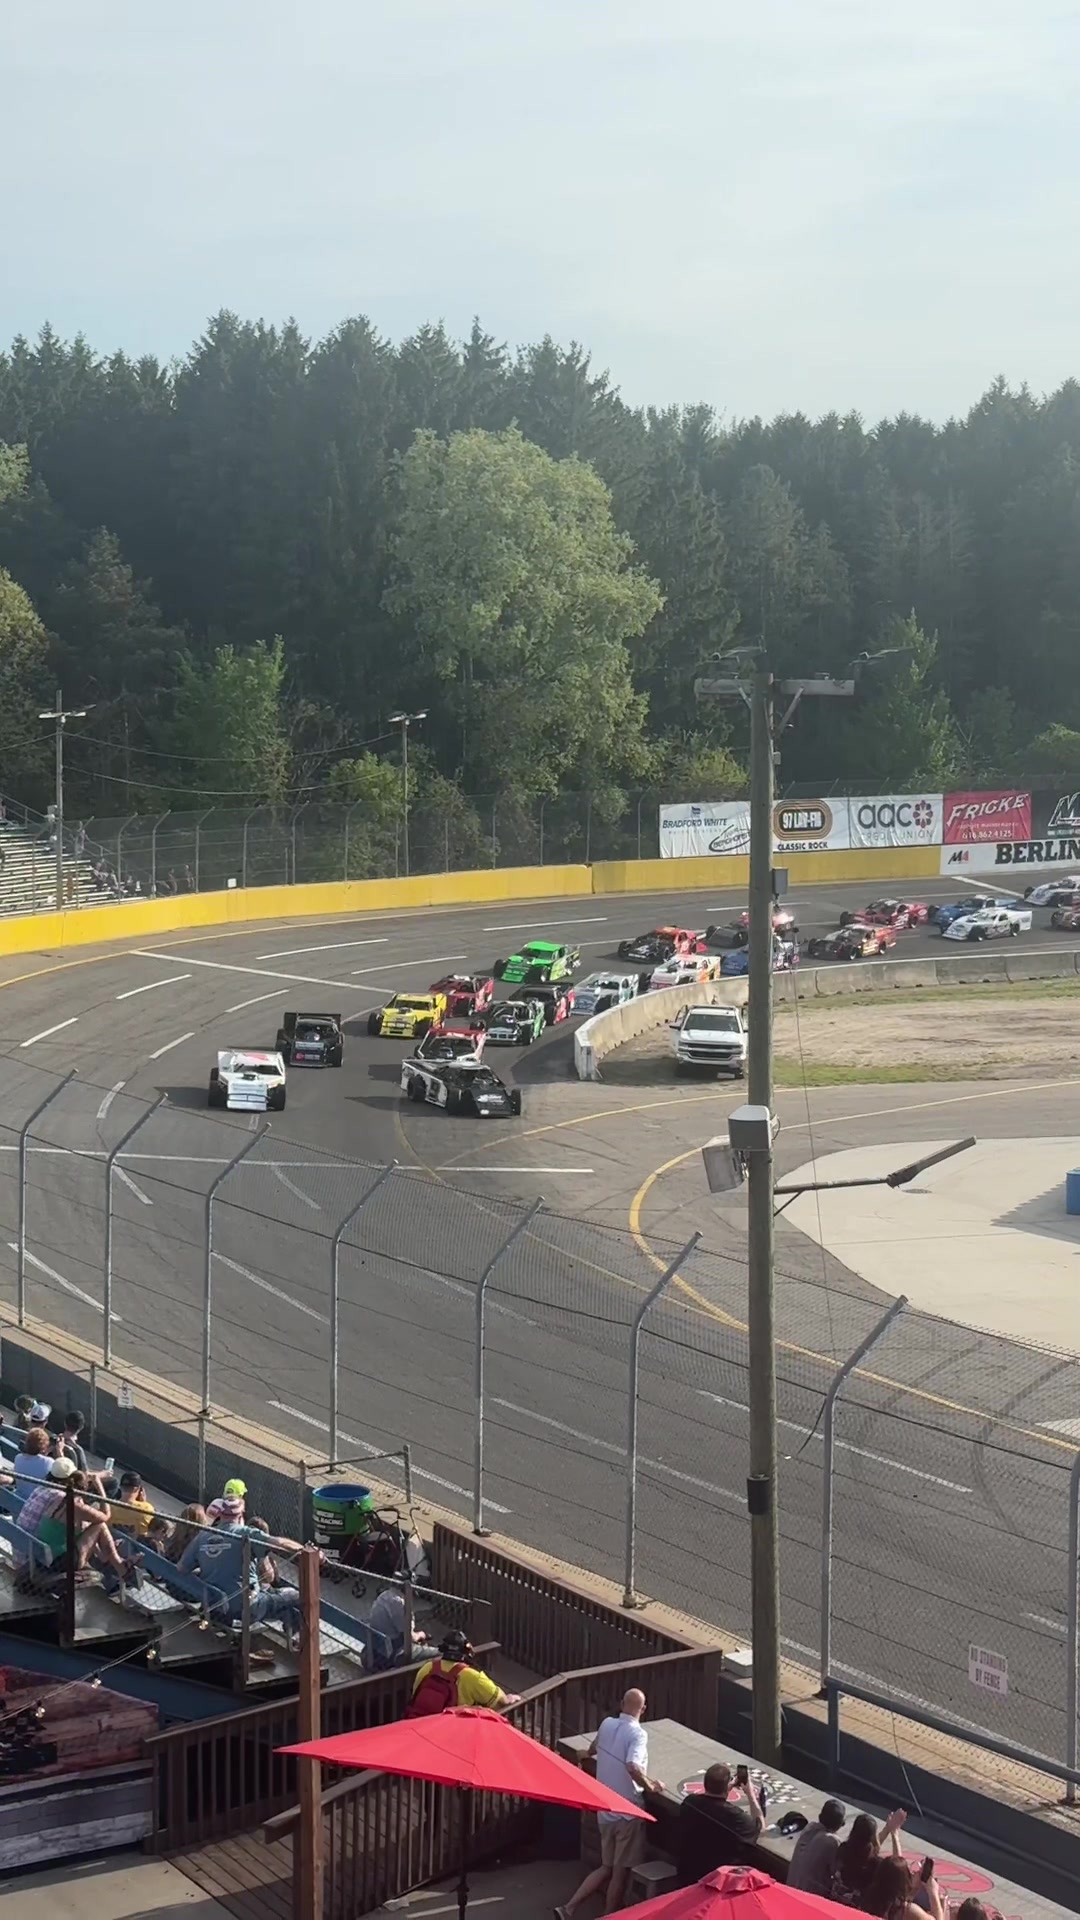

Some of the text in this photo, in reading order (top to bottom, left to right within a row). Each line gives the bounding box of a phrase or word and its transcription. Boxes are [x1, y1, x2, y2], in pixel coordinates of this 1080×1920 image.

[858, 803, 912, 829] aac
[946, 794, 1029, 827] FRICKE
[662, 818, 728, 829] BRADFORD WHITE
[782, 812, 792, 829] 97
[777, 841, 828, 851] CLASSIC ROCK
[995, 840, 1080, 865] BERLIN
[984, 1671, 1001, 1690] FENCE
